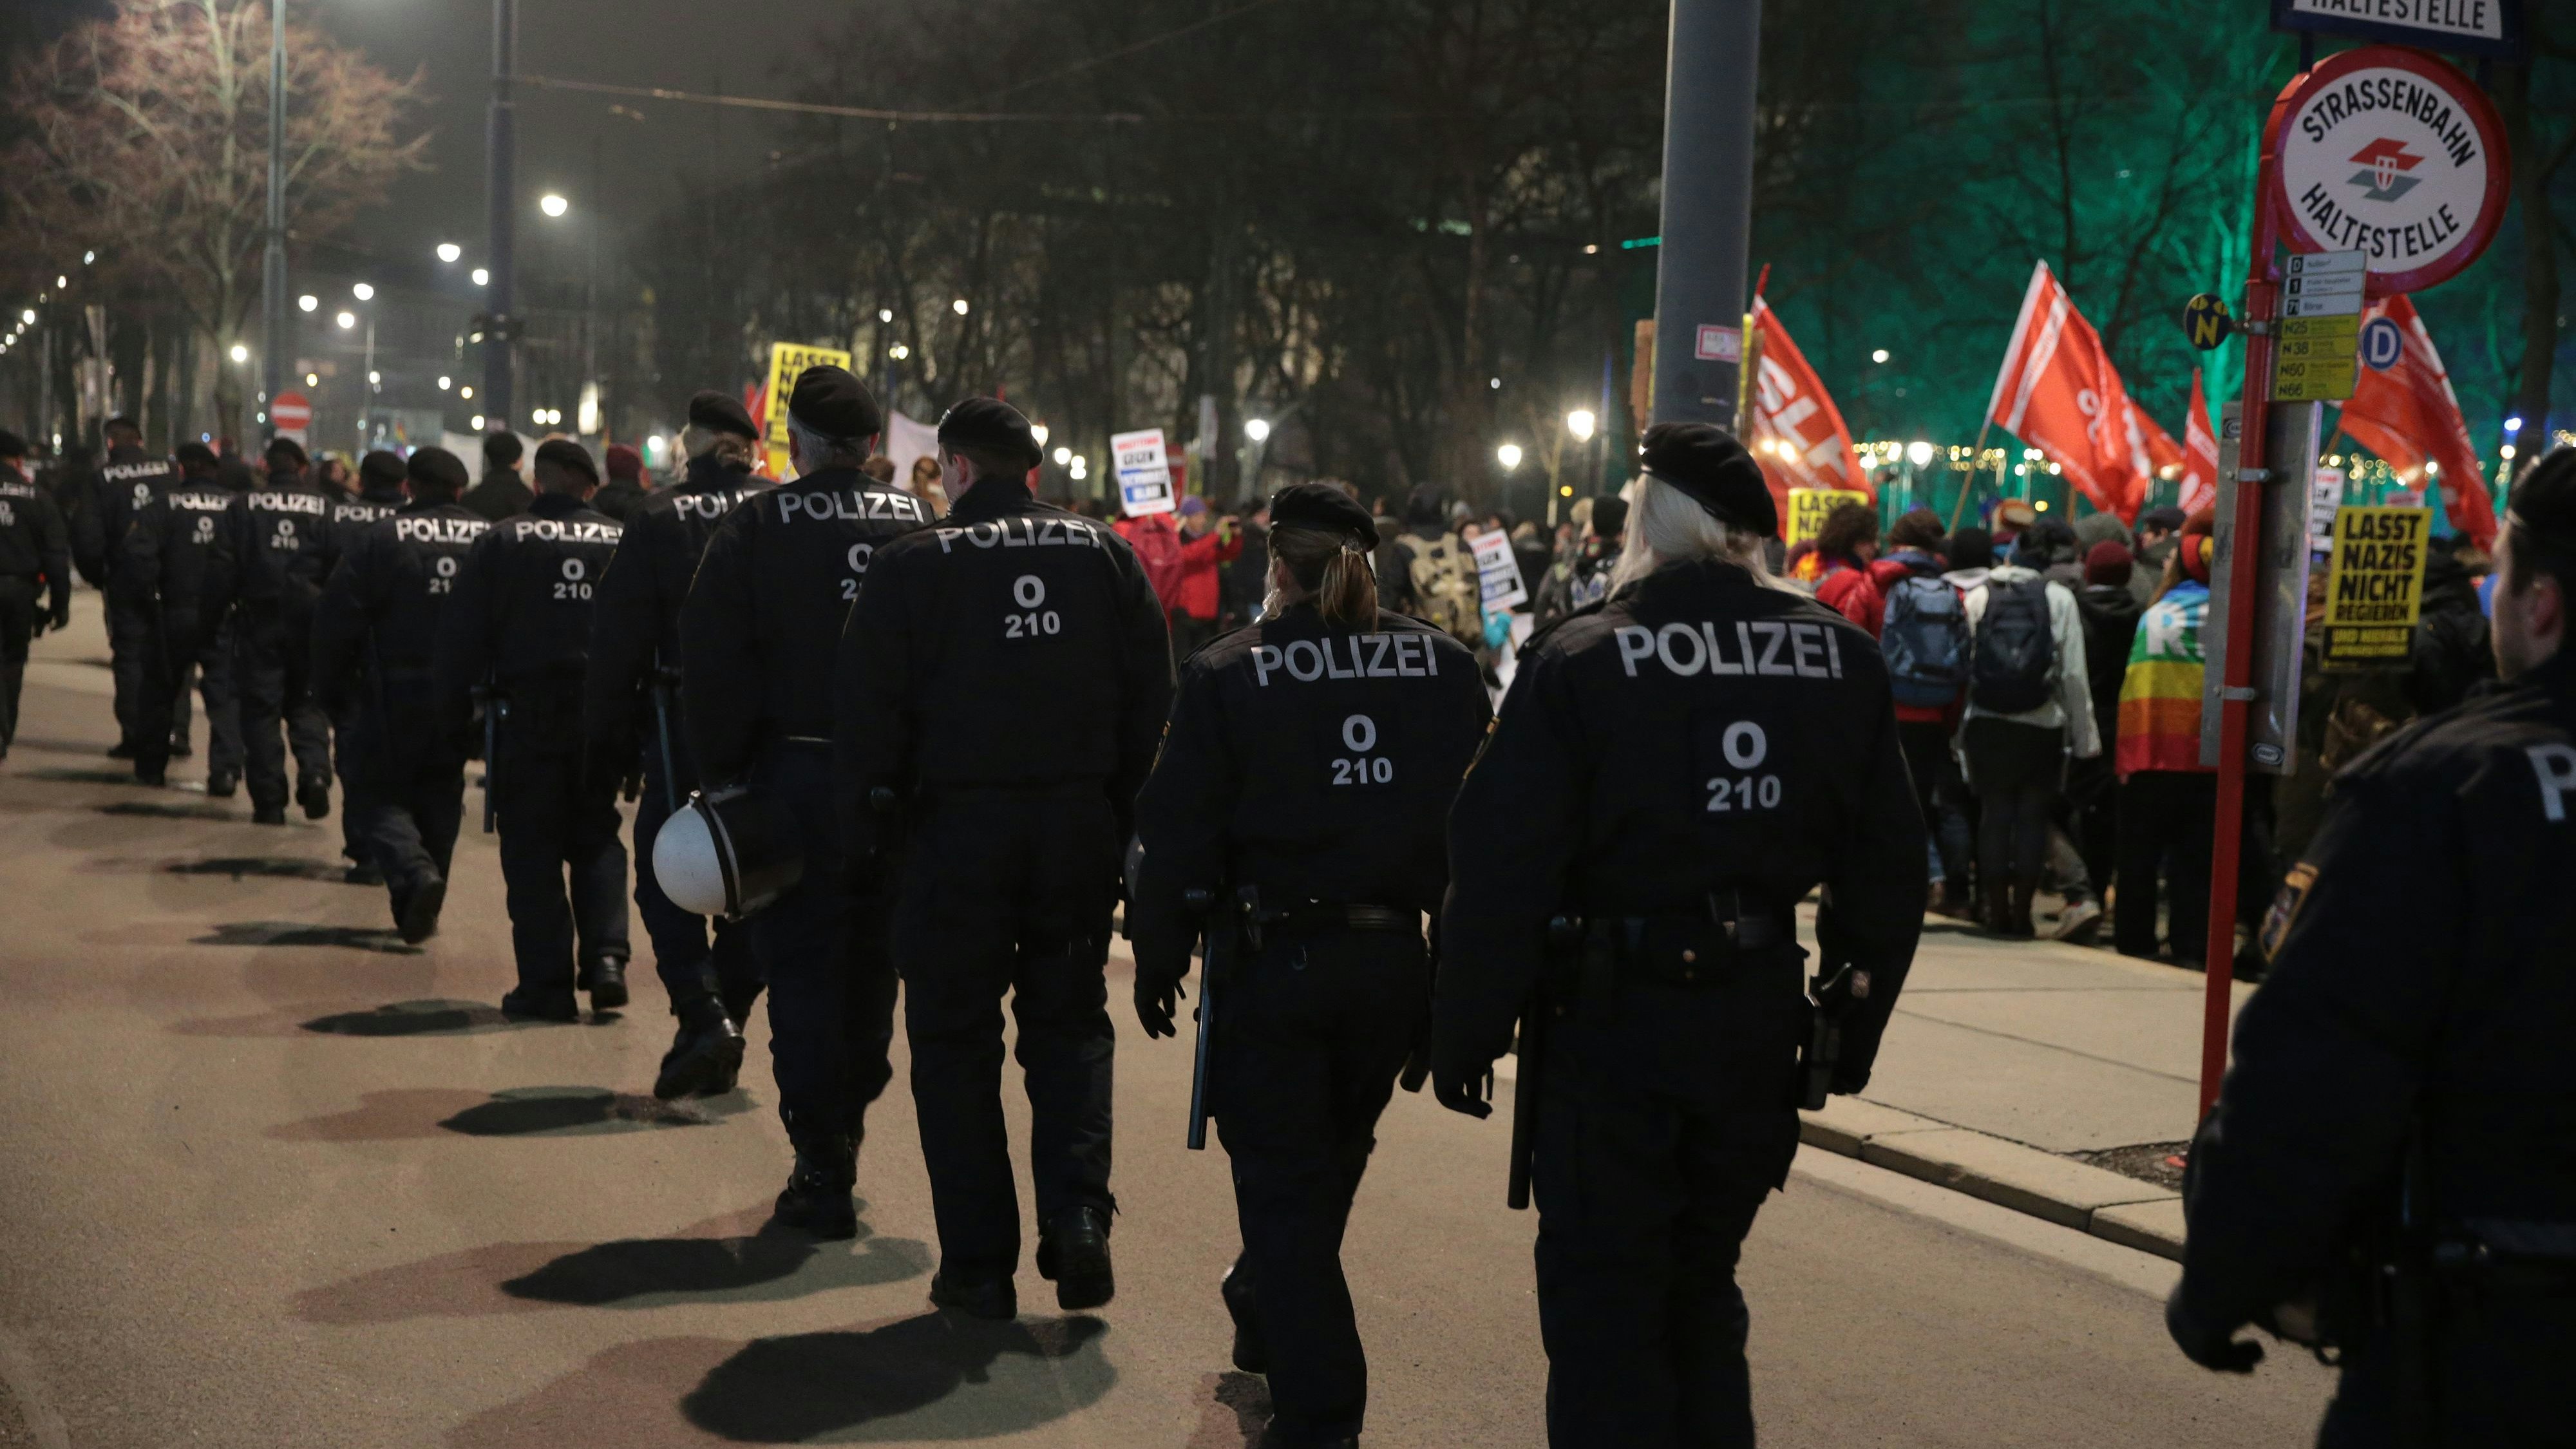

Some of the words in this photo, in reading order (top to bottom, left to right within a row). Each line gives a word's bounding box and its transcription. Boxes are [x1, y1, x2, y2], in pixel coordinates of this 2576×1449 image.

[2302, 77, 2476, 167] STRASSENBAHN
[2300, 182, 2459, 259] HALTESTELLE
[2195, 314, 2219, 346] N
[2370, 325, 2398, 363] D
[248, 491, 325, 515] POLIZEI
[777, 490, 924, 524] POLIZEI
[395, 517, 492, 544] POLIZE
[936, 517, 1101, 554] POLIZEI
[2344, 513, 2420, 540] LASST
[436, 556, 457, 578] O
[562, 558, 585, 581] O
[2342, 545, 2416, 571] NAZIS
[429, 578, 451, 594] 21
[553, 582, 592, 600] 210
[1014, 574, 1045, 609] O
[2338, 574, 2413, 601] NICHT
[1004, 611, 1061, 639] 210
[1250, 634, 1439, 687] POLIZEI
[1613, 621, 1844, 680] POLIZEI
[1342, 714, 1377, 752] O
[1721, 720, 1767, 770] O
[1331, 757, 1393, 786] 210
[1706, 774, 1782, 813] 210
